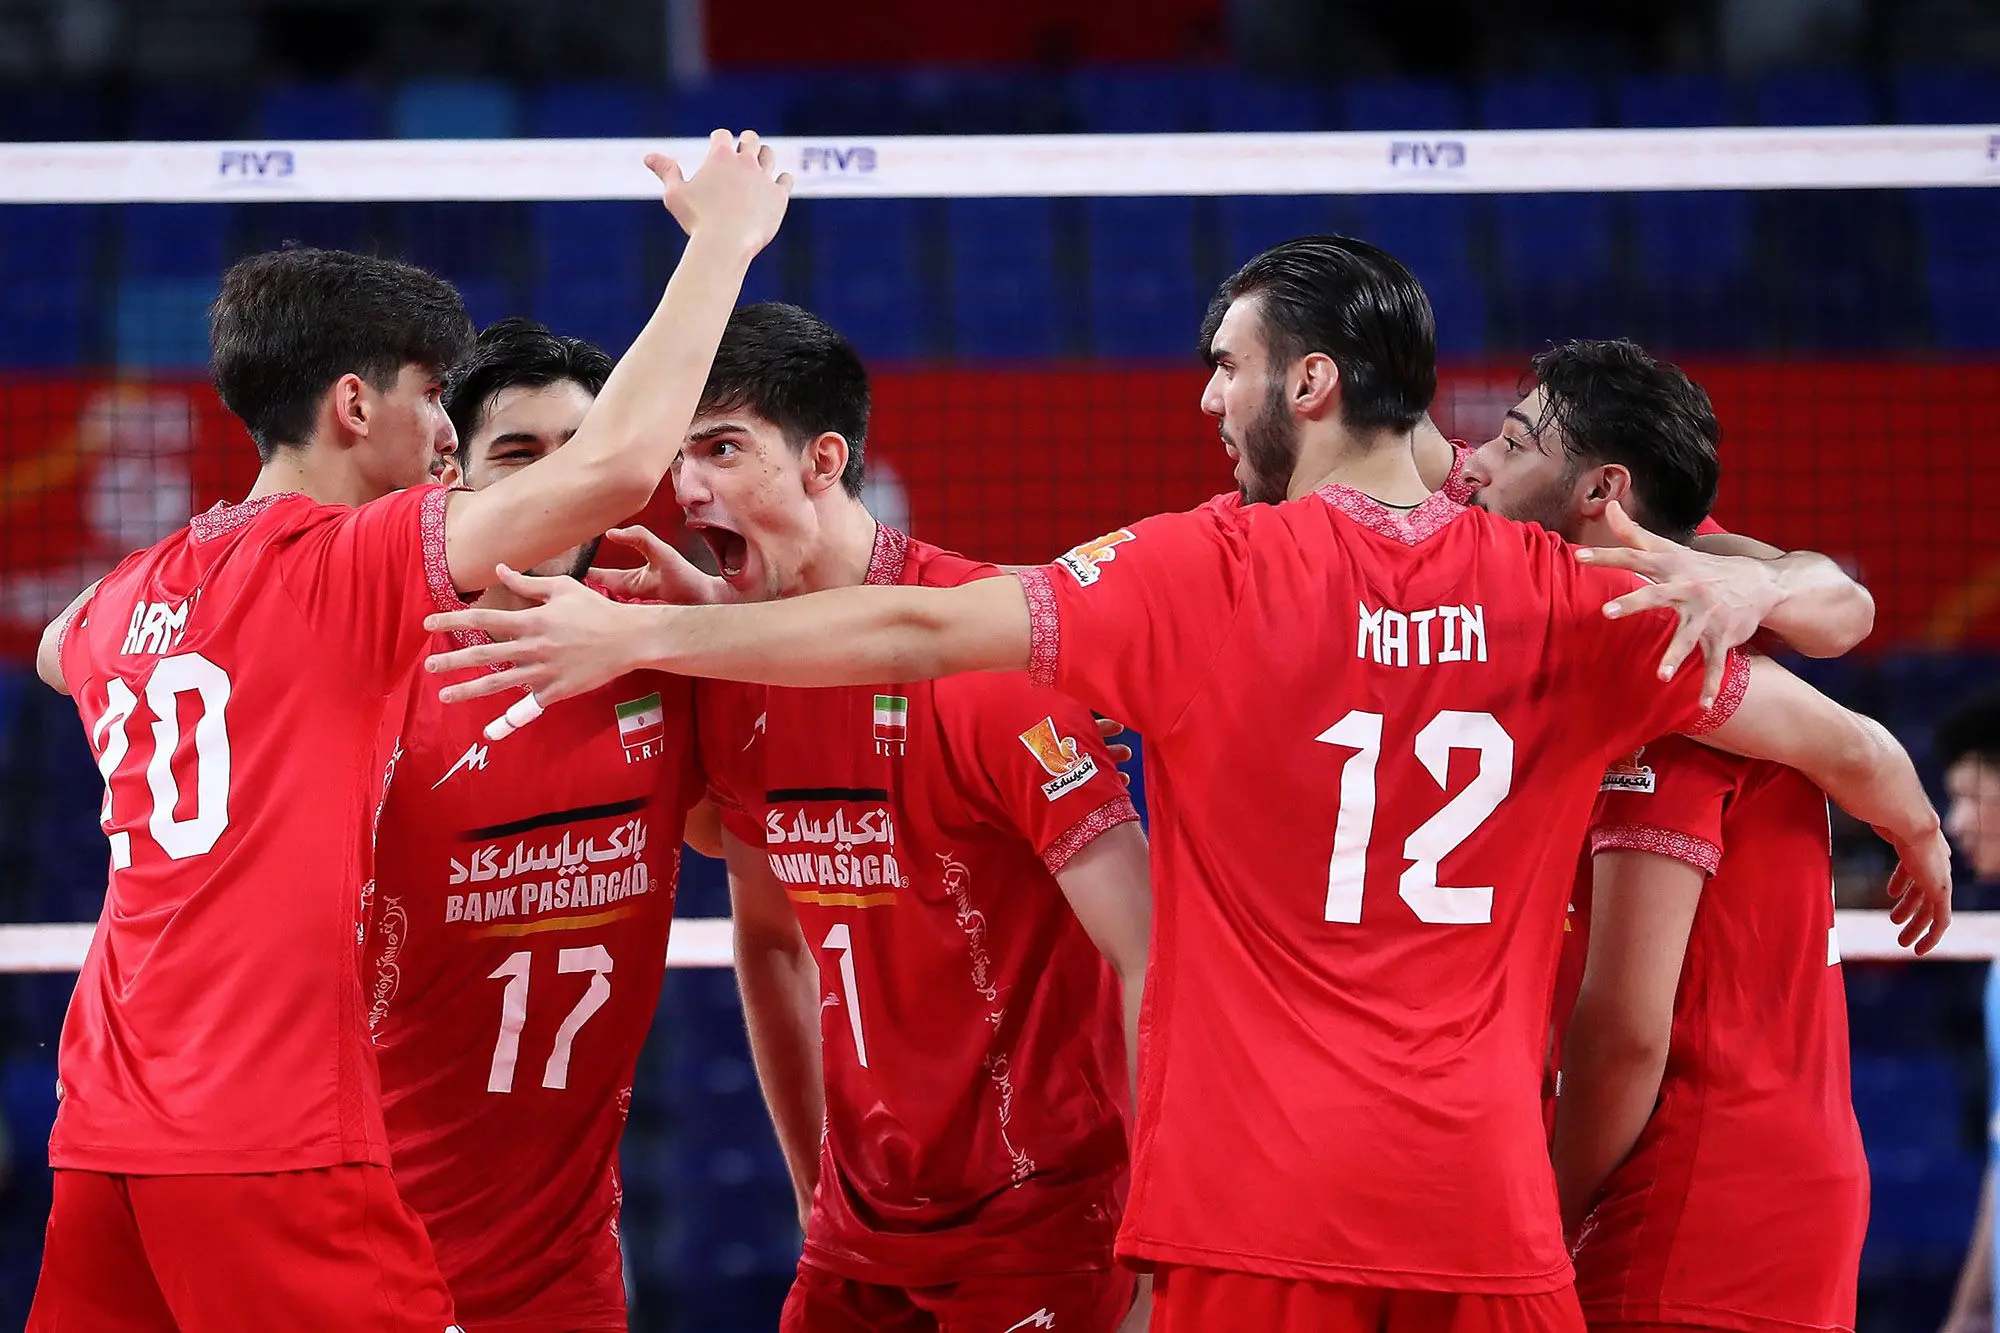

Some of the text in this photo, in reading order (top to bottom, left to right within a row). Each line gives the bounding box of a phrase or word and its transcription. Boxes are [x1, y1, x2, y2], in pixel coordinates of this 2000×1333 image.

[220, 150, 294, 176] FIVB
[802, 147, 876, 173] FIVB
[1390, 141, 1466, 168] FIVB
[120, 587, 202, 655] ARM
[1357, 601, 1487, 667] MATIN
[1314, 709, 1514, 925] 12
[445, 862, 649, 924] BANK PASARGAD
[487, 944, 614, 1093] 17
[821, 923, 869, 1069] 1
